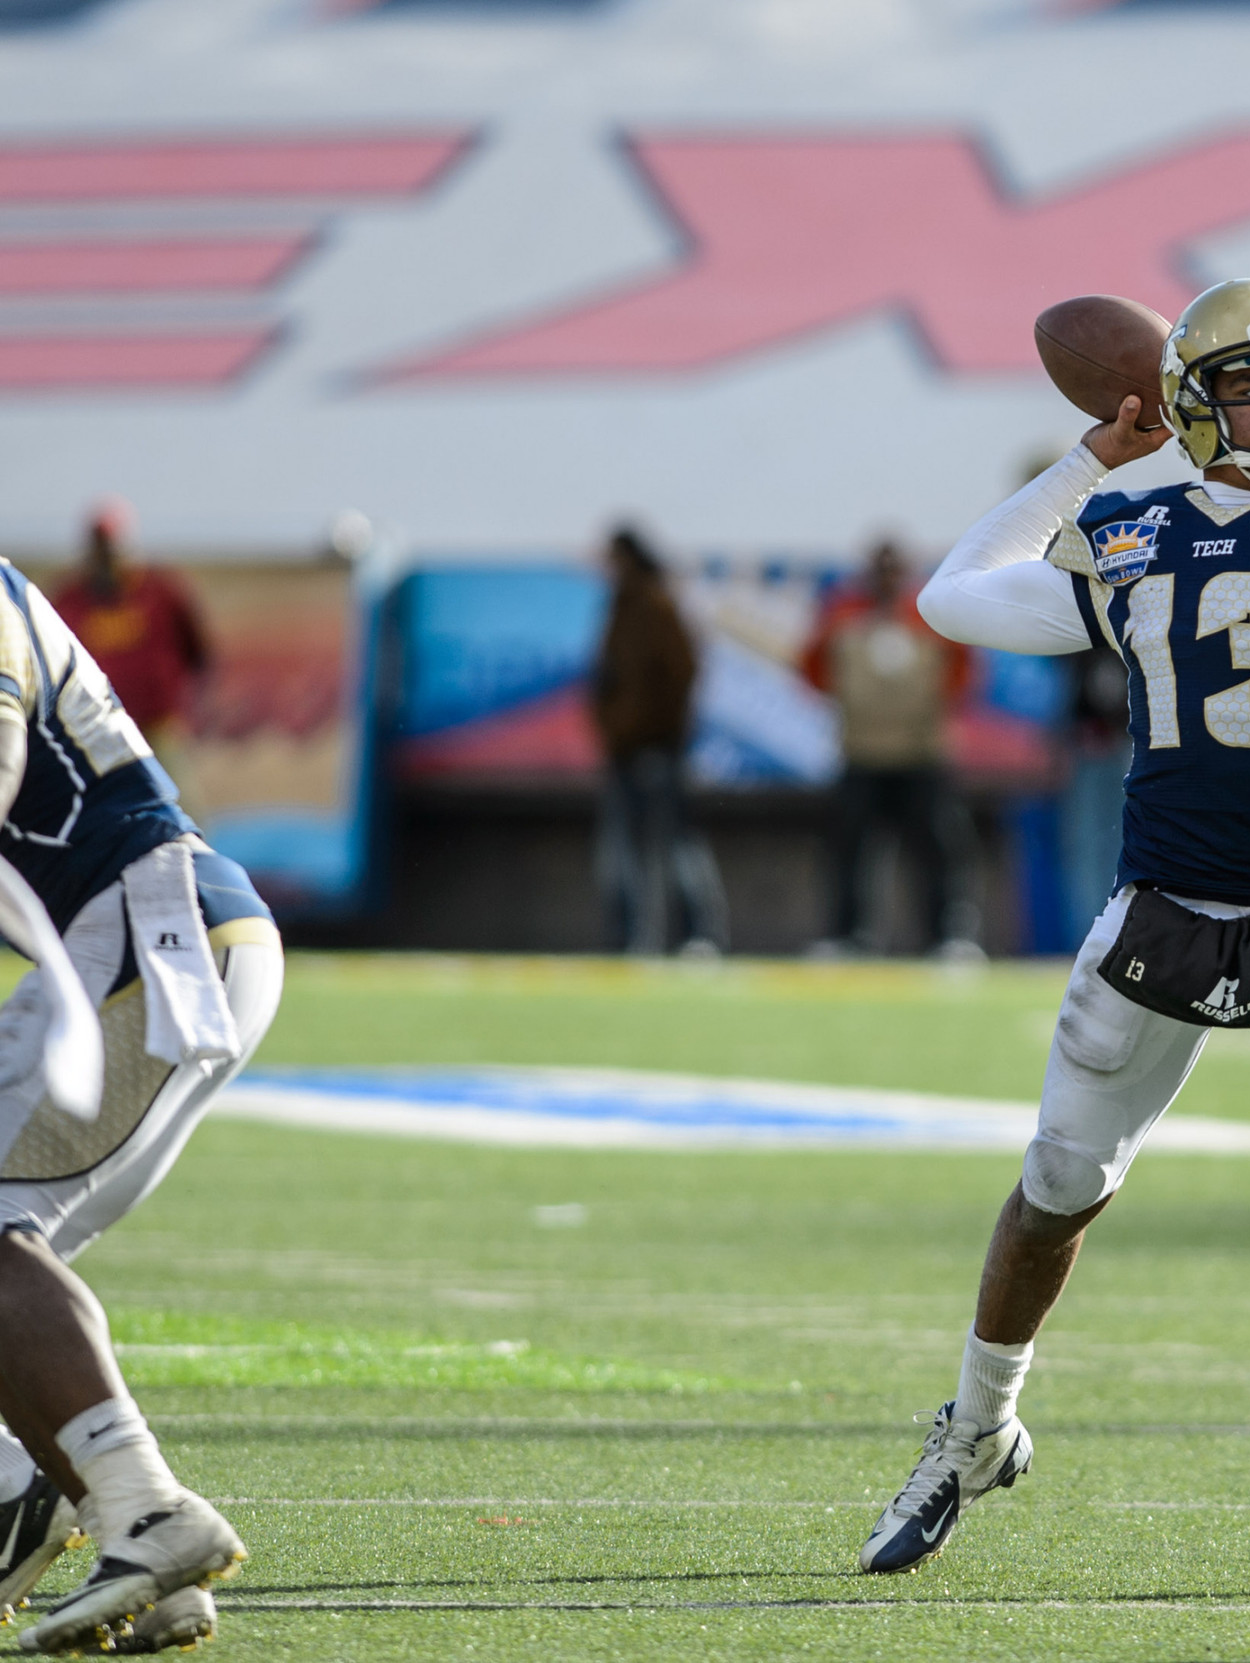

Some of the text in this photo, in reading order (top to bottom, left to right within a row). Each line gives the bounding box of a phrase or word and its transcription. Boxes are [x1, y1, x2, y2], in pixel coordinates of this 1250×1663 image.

[1137, 516, 1171, 527] RUSSELL
[1192, 539, 1237, 557] TECH
[1112, 550, 1149, 565] HYUNDAI
[1120, 567, 1143, 579] BOWL
[1125, 957, 1145, 982] 13
